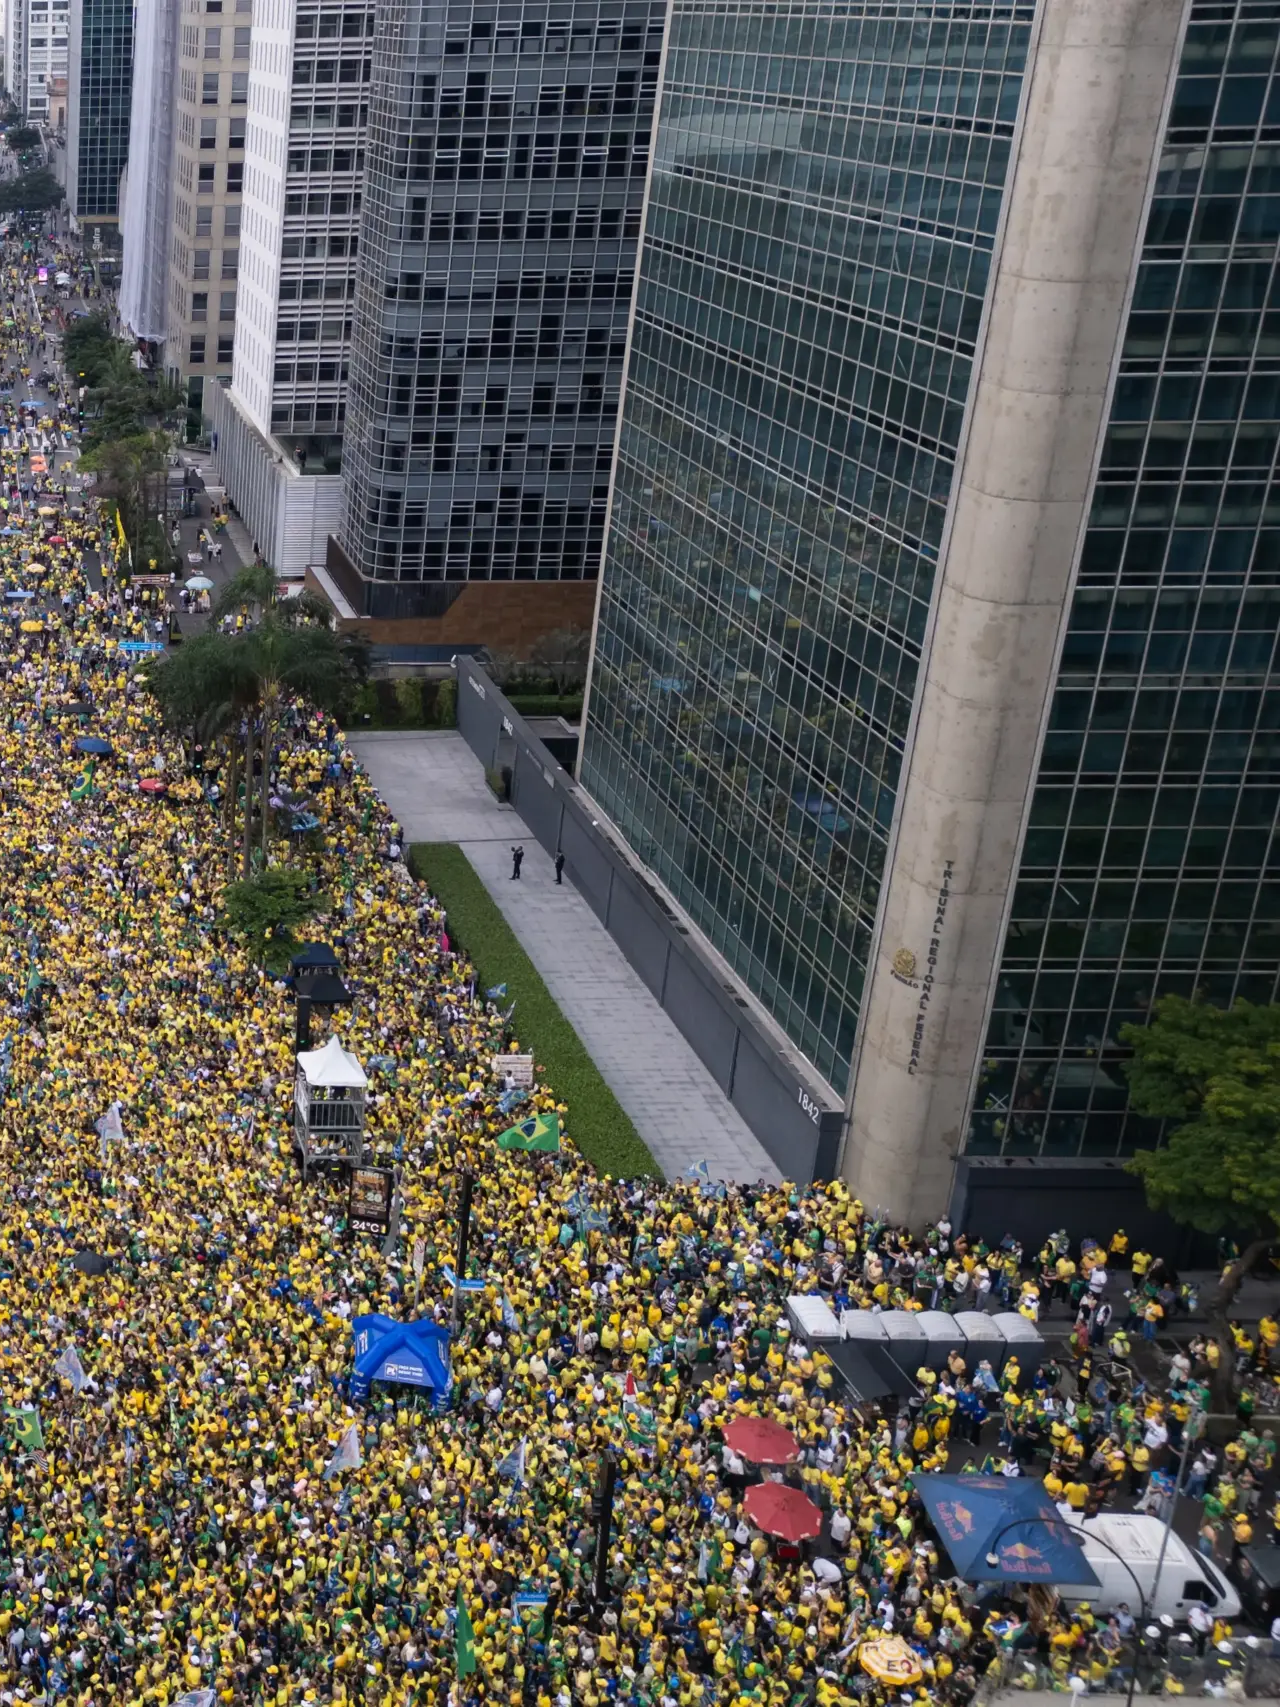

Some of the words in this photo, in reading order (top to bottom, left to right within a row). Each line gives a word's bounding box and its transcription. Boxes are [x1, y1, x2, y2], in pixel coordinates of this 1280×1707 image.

[92, 227, 101, 250] Safra
[933, 860, 954, 934] TRIBUNAL
[919, 938, 940, 1011] REGIONAL
[907, 1013, 924, 1076] FEDERAL
[798, 1087, 819, 1125] 1842
[352, 1219, 380, 1233] 24°C
